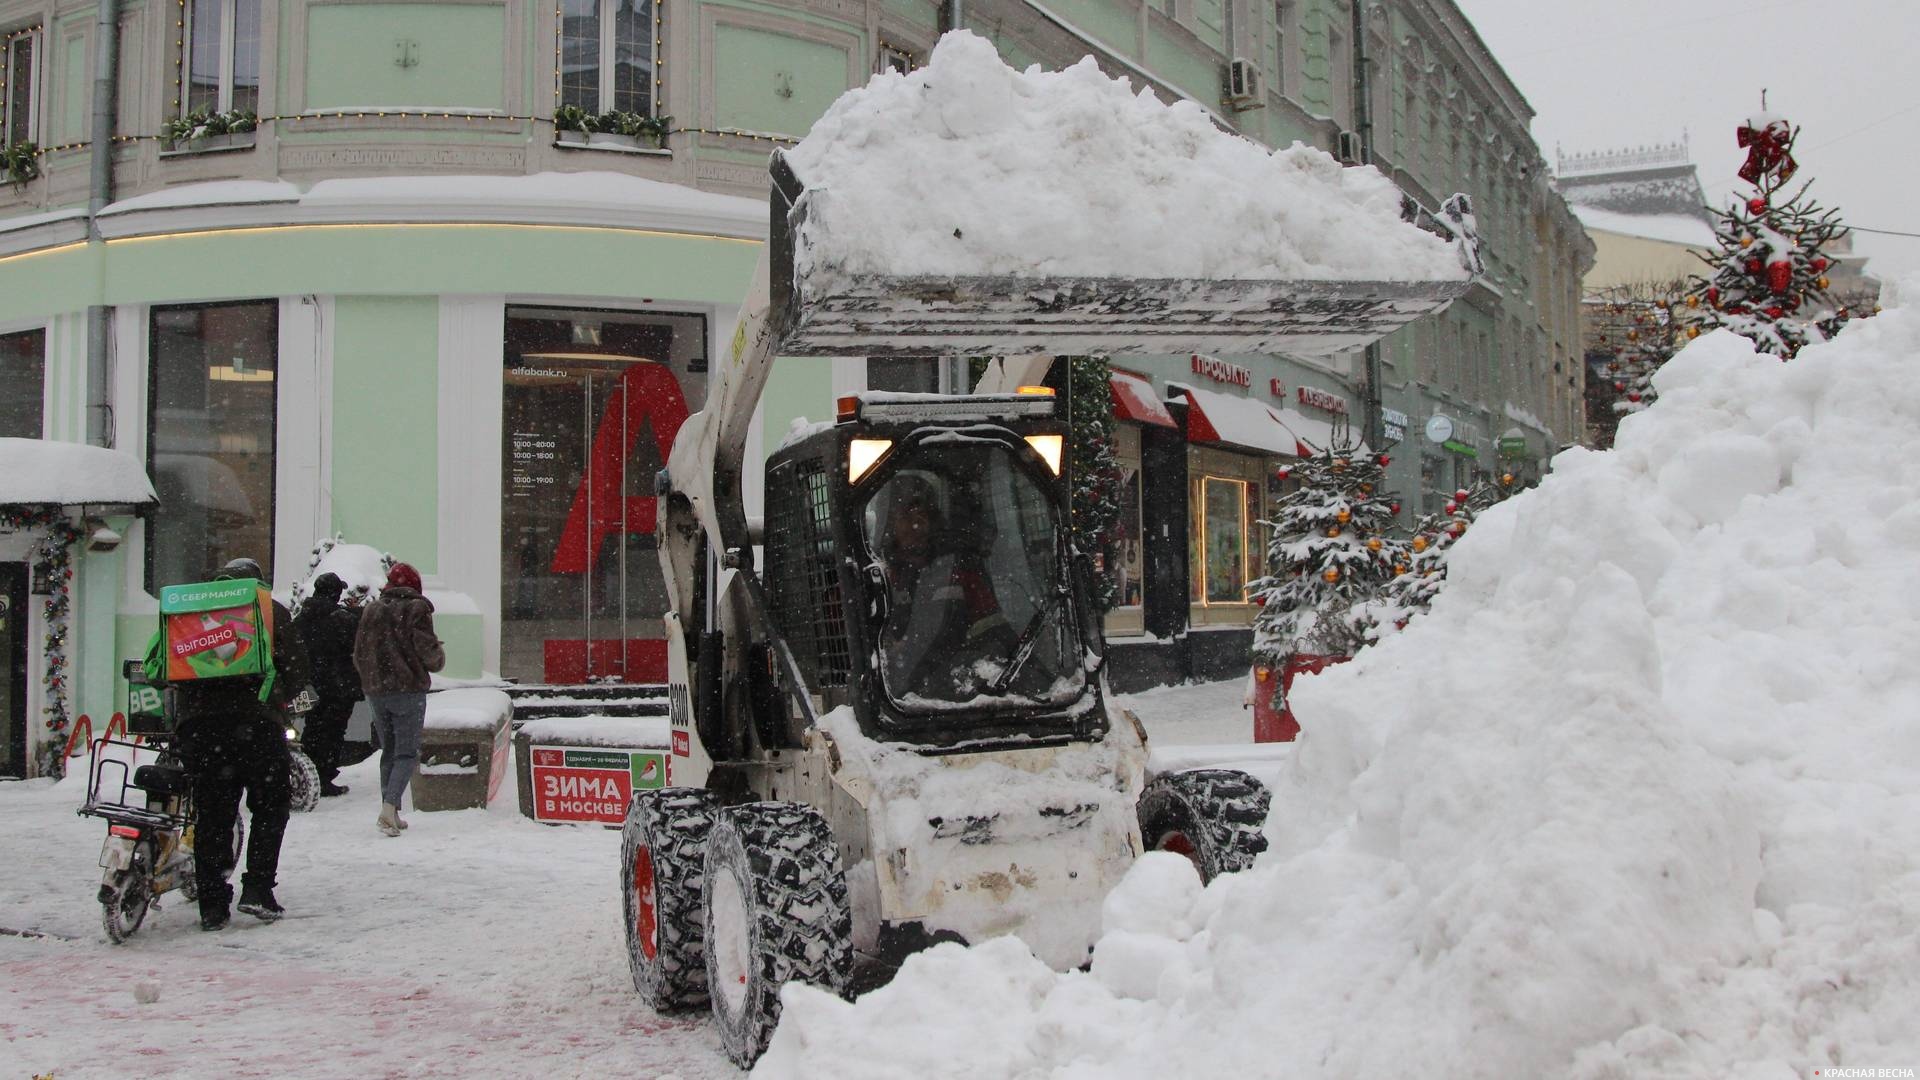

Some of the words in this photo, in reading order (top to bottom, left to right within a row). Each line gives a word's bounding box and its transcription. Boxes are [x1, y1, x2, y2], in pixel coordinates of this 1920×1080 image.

[511, 366, 567, 378] alfabank.ru
[1193, 353, 1251, 387] ПРОДУКТЫ
[176, 629, 233, 655] ВЫГОДНО
[670, 683, 688, 727] S300
[543, 774, 622, 801] ЗИМА
[545, 800, 556, 812] В
[560, 801, 623, 816] МОСКВЕ
